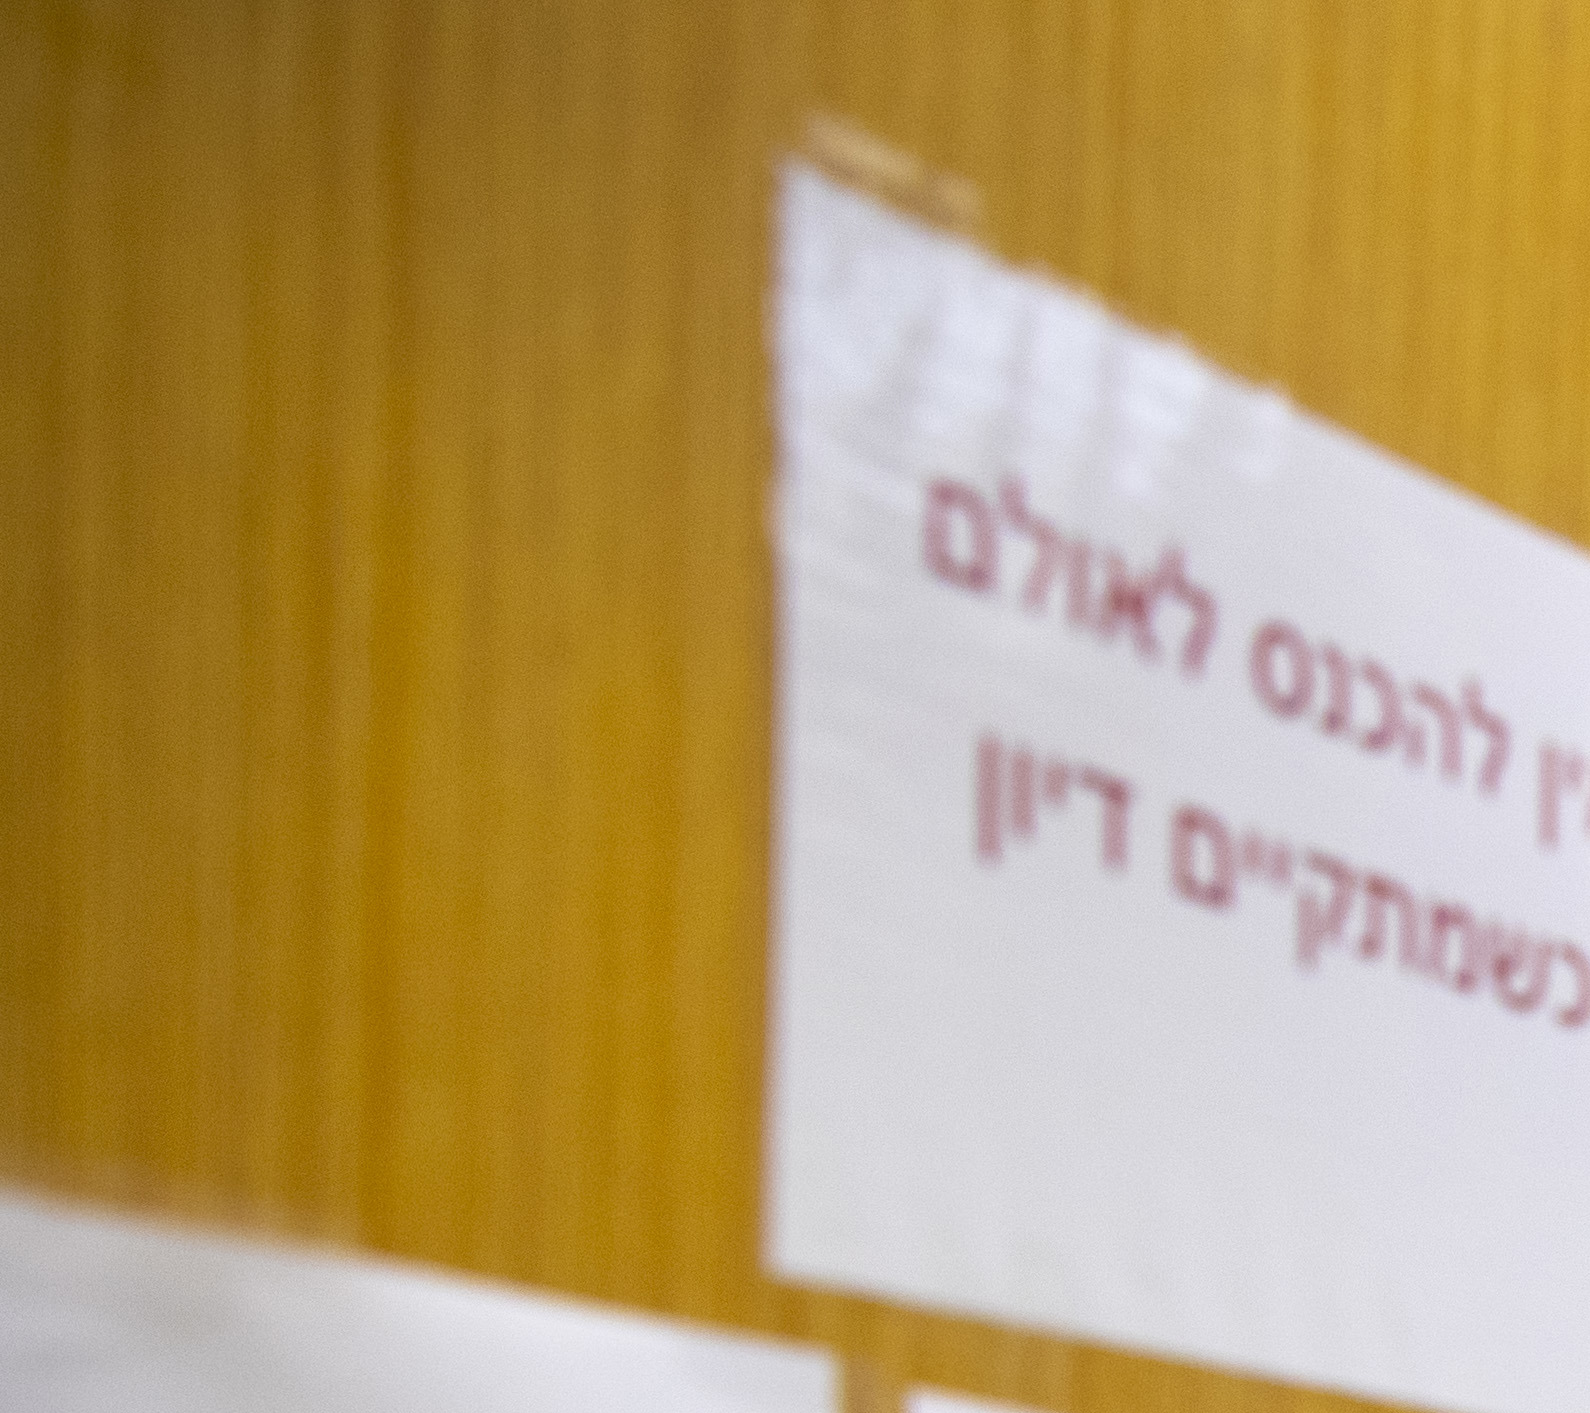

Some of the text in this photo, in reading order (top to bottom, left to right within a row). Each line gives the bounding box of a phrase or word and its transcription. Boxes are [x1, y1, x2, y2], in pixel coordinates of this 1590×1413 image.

[923, 474, 1217, 676] לאולם
[1251, 622, 1510, 792] להכנס
[977, 731, 1134, 868] דיון
